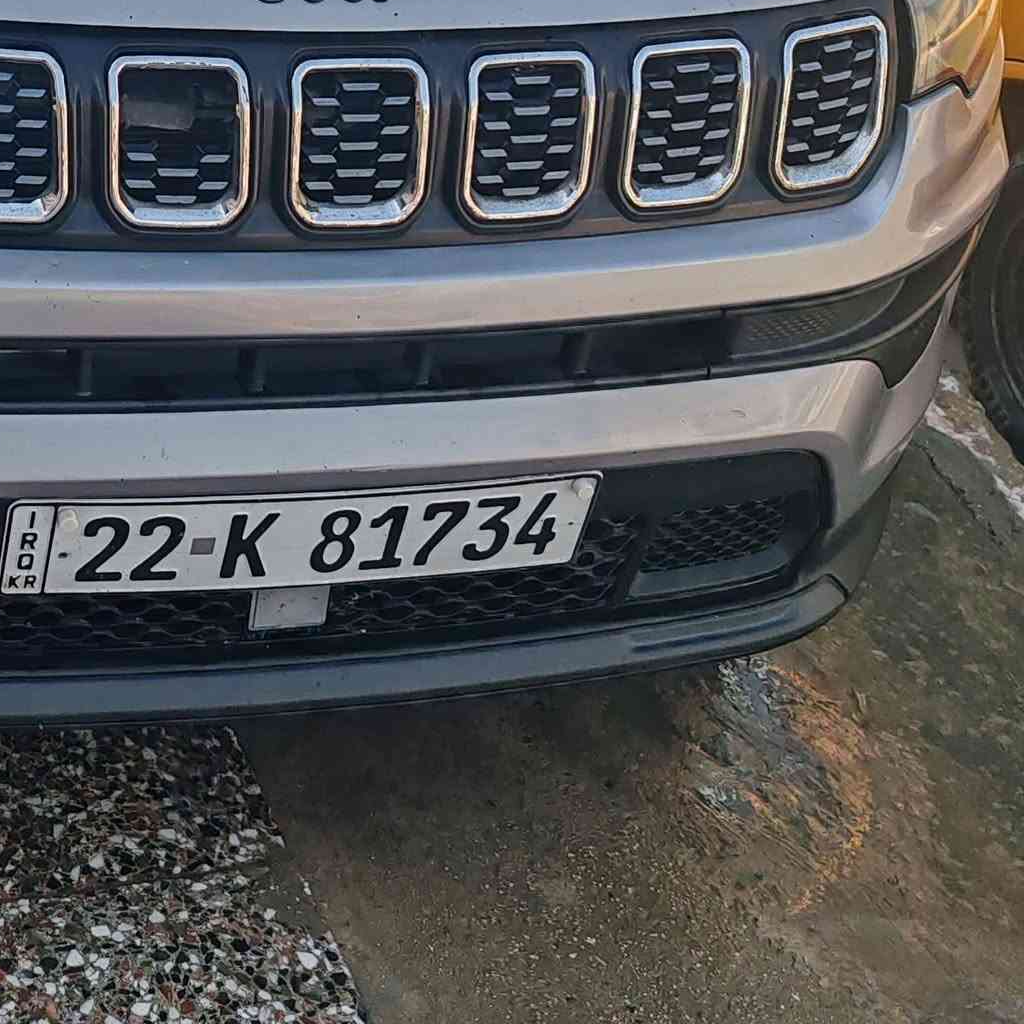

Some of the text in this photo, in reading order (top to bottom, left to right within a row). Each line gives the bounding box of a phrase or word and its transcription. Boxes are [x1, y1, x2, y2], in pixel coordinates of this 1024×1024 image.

[75, 492, 558, 582] 22 K 81734
